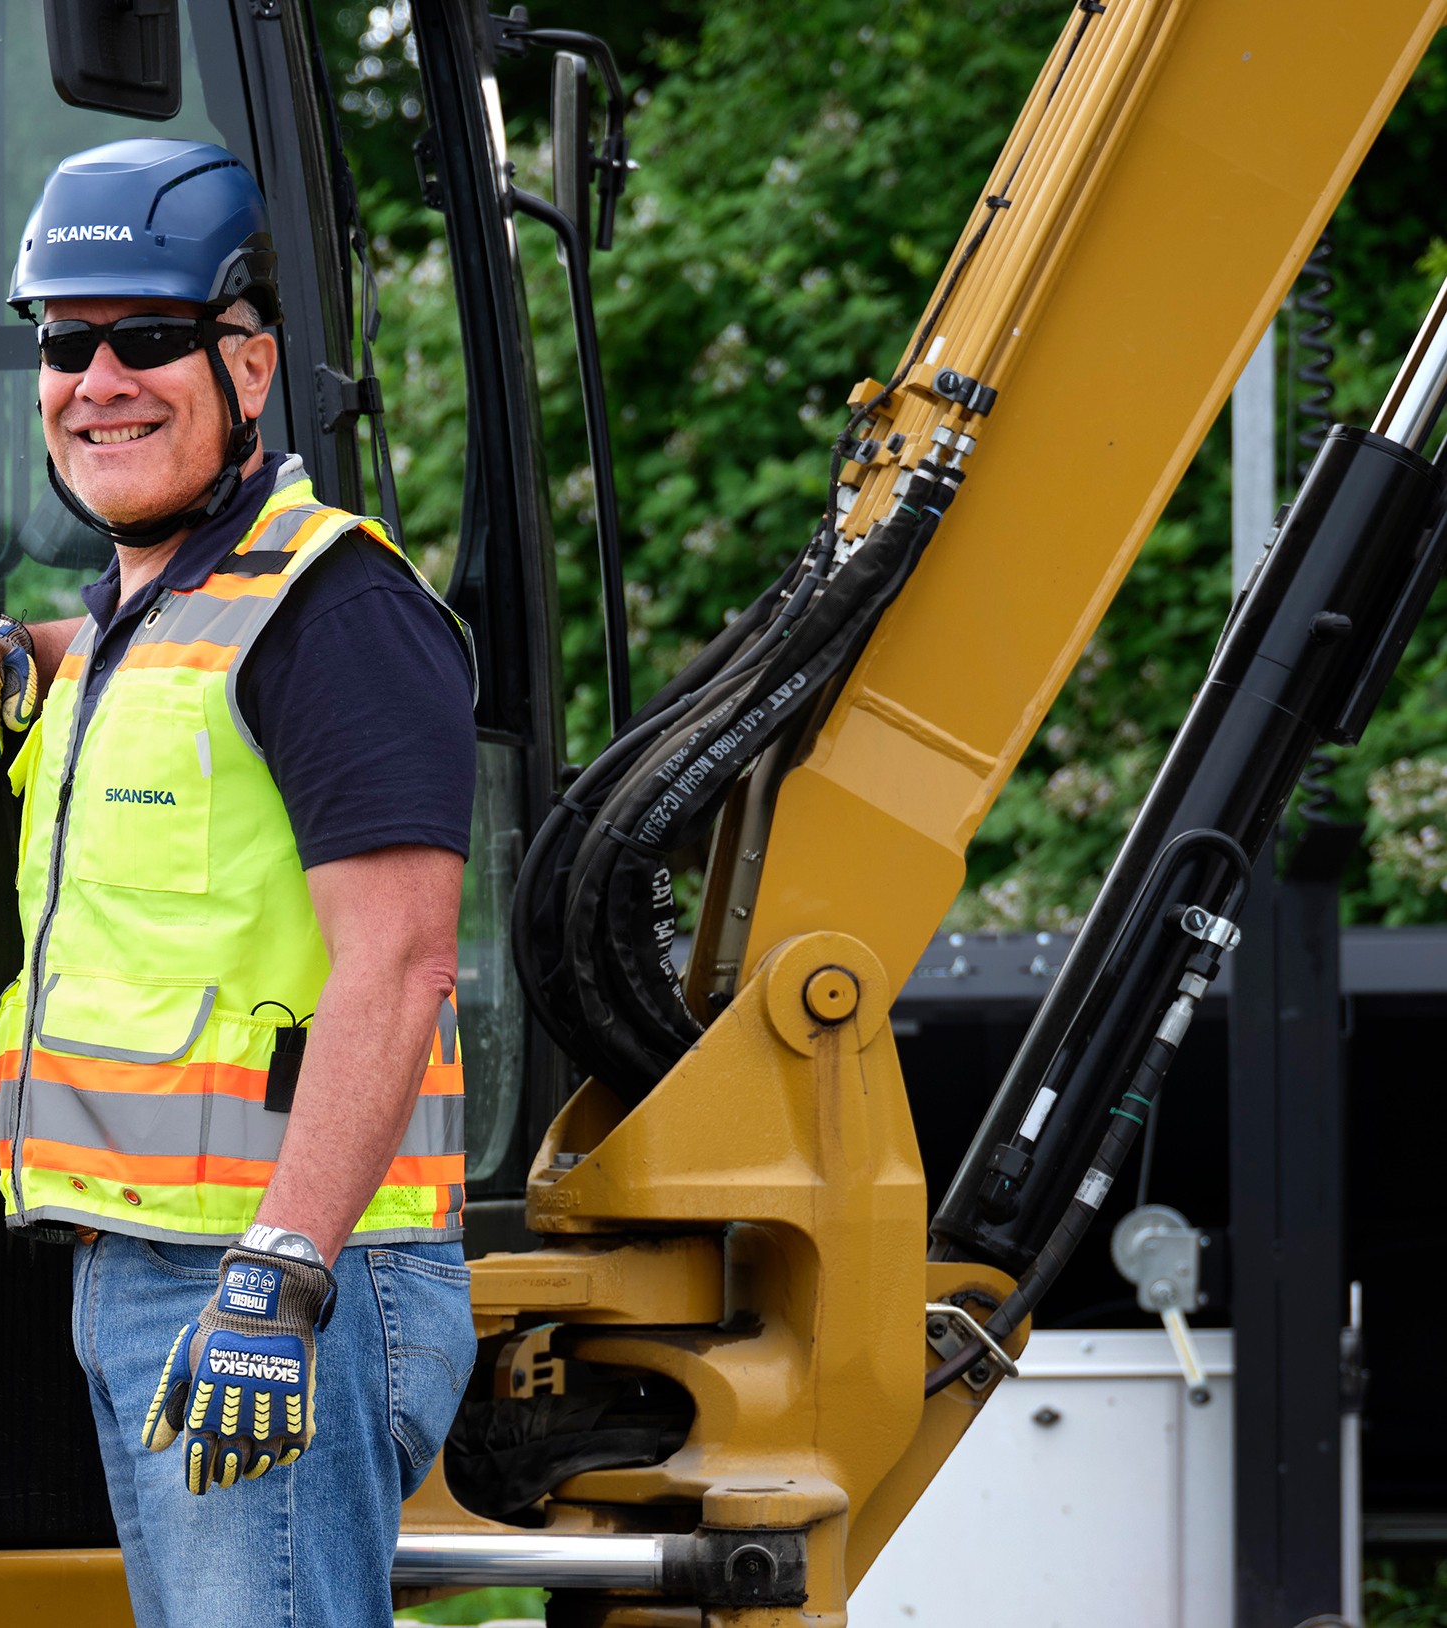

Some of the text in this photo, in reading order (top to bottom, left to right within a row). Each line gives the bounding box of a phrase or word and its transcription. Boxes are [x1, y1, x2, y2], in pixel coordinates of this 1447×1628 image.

[46, 225, 134, 244] SKANSKA
[767, 672, 807, 711] CAT
[707, 707, 766, 761] 541-7088
[674, 755, 715, 795] MSHA
[105, 788, 176, 805] SKANSKA
[652, 867, 675, 909] CAT
[209, 1348, 301, 1370] Hands For A Living
[209, 1358, 300, 1384] SKANSKA
